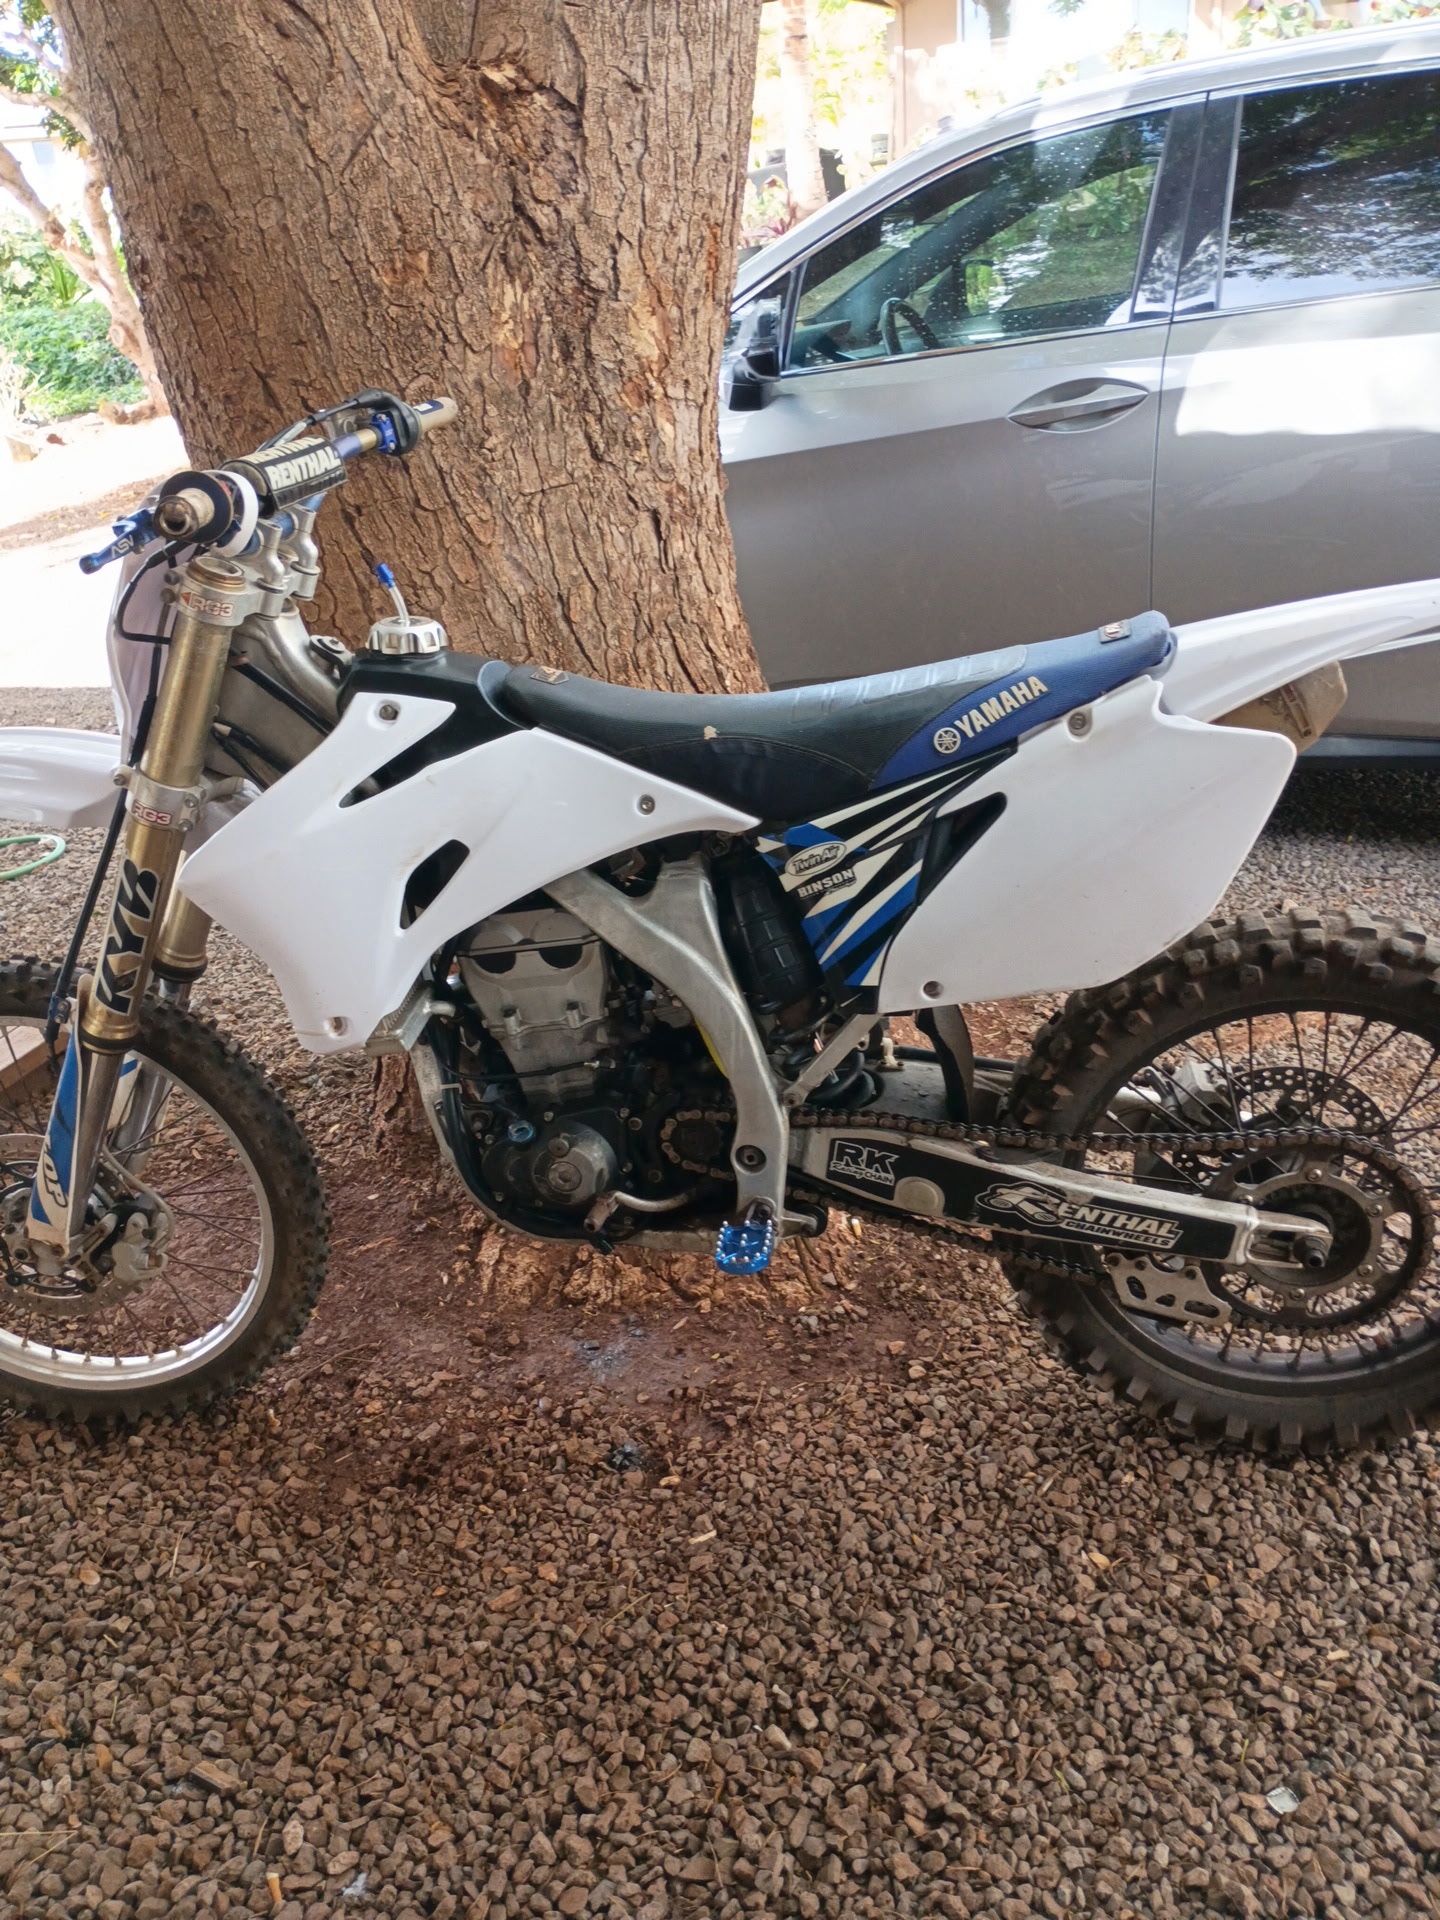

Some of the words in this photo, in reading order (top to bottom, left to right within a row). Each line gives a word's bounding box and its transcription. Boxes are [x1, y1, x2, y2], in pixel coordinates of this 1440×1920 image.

[265, 446, 341, 490] RENTHAL
[111, 535, 134, 559] ASV
[190, 593, 234, 617] RG3
[953, 675, 1049, 738] YAMAHA
[132, 800, 172, 826] RG3
[793, 854, 821, 874] Twin
[820, 845, 840, 860] Air
[797, 868, 855, 898] HINSON
[96, 857, 159, 1016] KYB
[833, 1141, 899, 1176] RK
[864, 1170, 894, 1185] CHAIN
[1064, 1219, 1172, 1248] CHAINWHEELS
